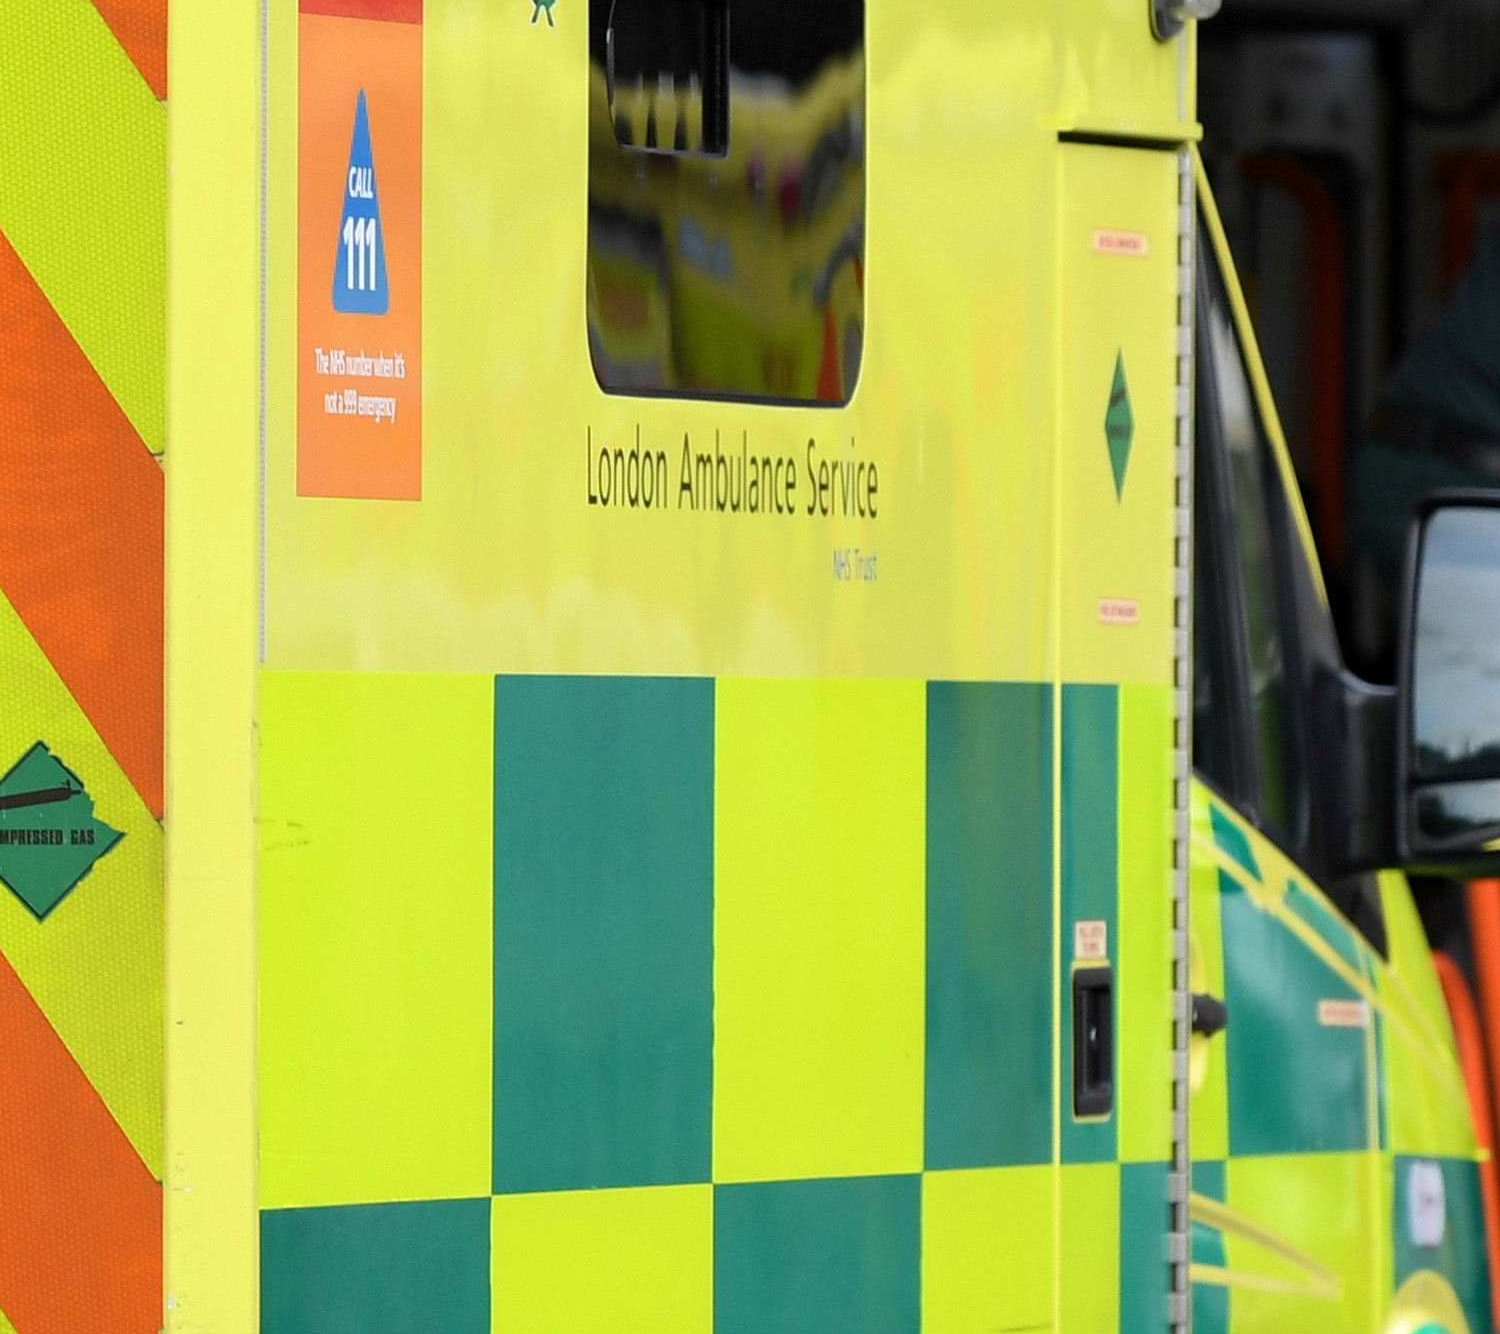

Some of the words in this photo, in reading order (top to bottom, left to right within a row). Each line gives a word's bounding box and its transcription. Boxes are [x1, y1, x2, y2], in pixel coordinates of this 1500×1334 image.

[349, 165, 374, 199] CALL
[342, 215, 377, 292] 111
[314, 347, 329, 375] The
[586, 423, 668, 510] London
[677, 427, 797, 516] Ambulance
[806, 434, 879, 518] Service
[832, 547, 852, 582] NHS
[70, 828, 96, 846] GAS
